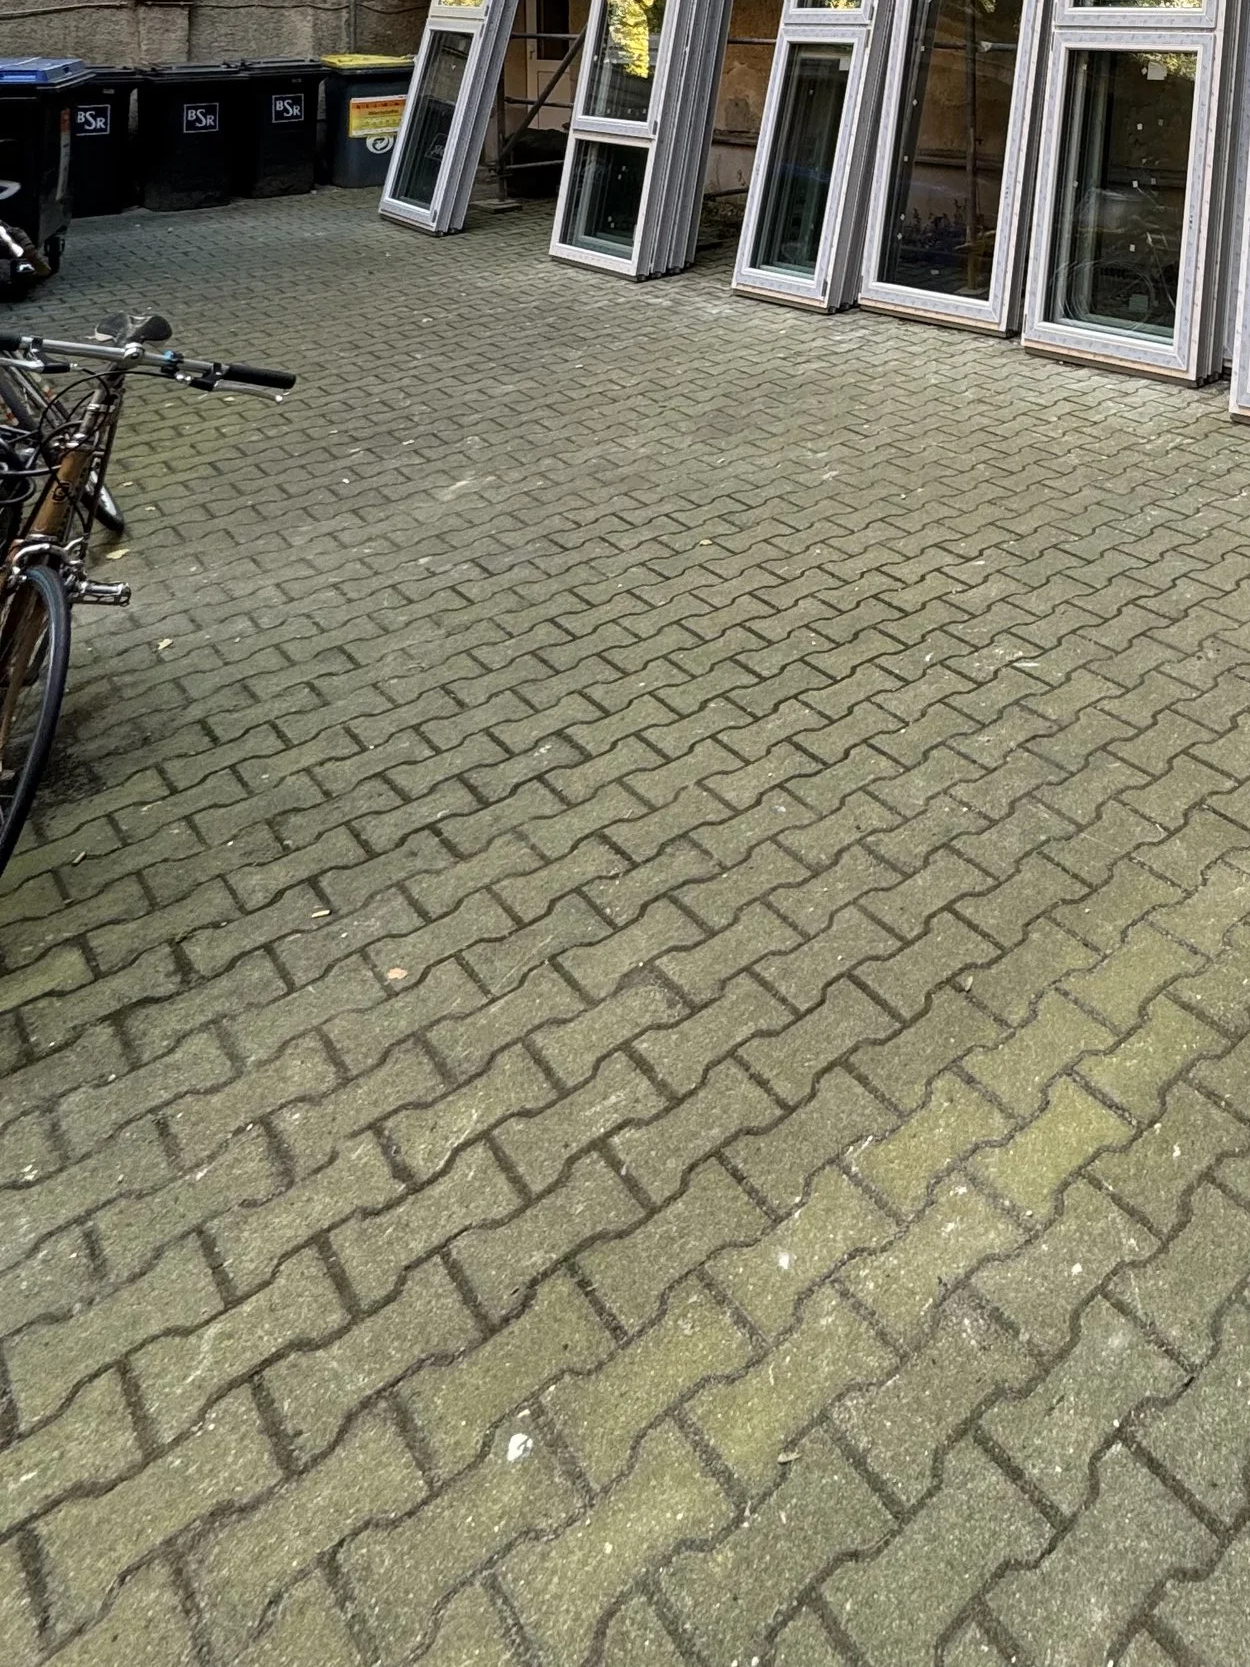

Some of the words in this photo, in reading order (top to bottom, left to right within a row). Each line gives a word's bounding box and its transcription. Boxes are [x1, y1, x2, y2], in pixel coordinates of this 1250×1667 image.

[275, 99, 301, 117] BSR
[77, 111, 106, 130] BSR
[187, 109, 215, 127] BSR
